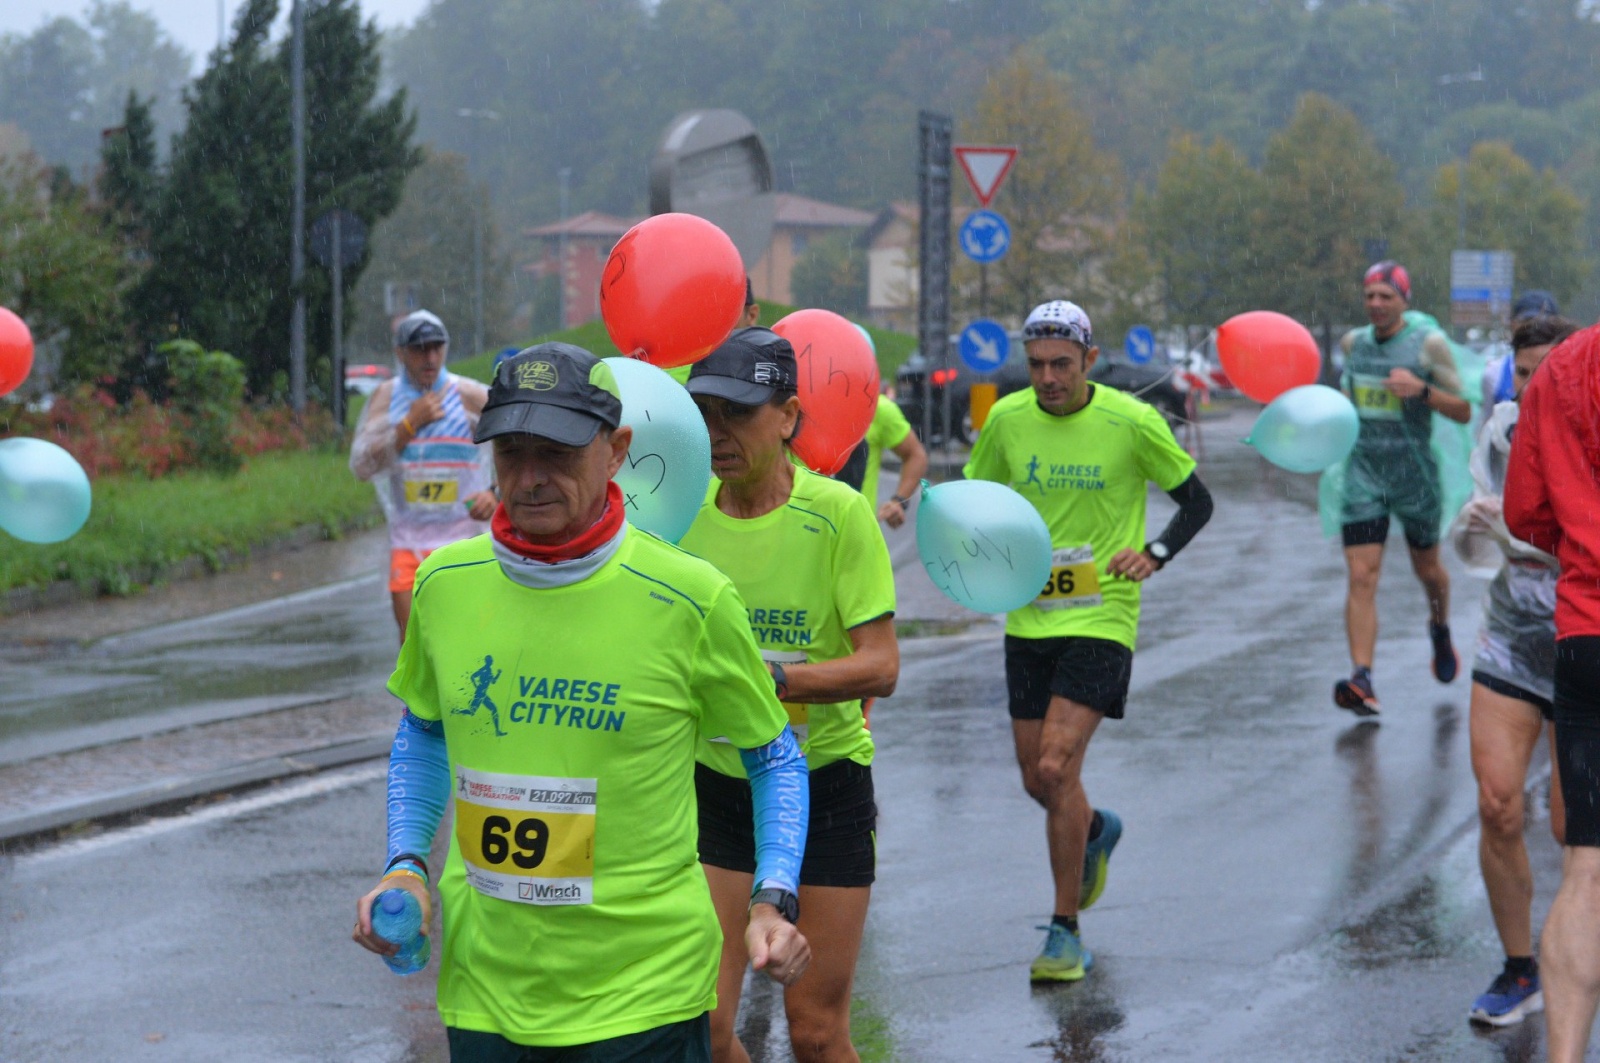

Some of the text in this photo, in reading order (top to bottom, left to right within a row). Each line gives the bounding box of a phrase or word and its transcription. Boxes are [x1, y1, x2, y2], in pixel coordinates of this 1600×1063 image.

[1049, 463, 1102, 478] VARESE
[418, 483, 444, 500] 47
[1047, 477, 1106, 491] CITYRUN
[519, 676, 621, 706] VARESE
[509, 701, 626, 732] CITYRUN
[532, 790, 593, 804] 21.097 km
[481, 815, 549, 870] 69
[534, 883, 581, 899] Winch
